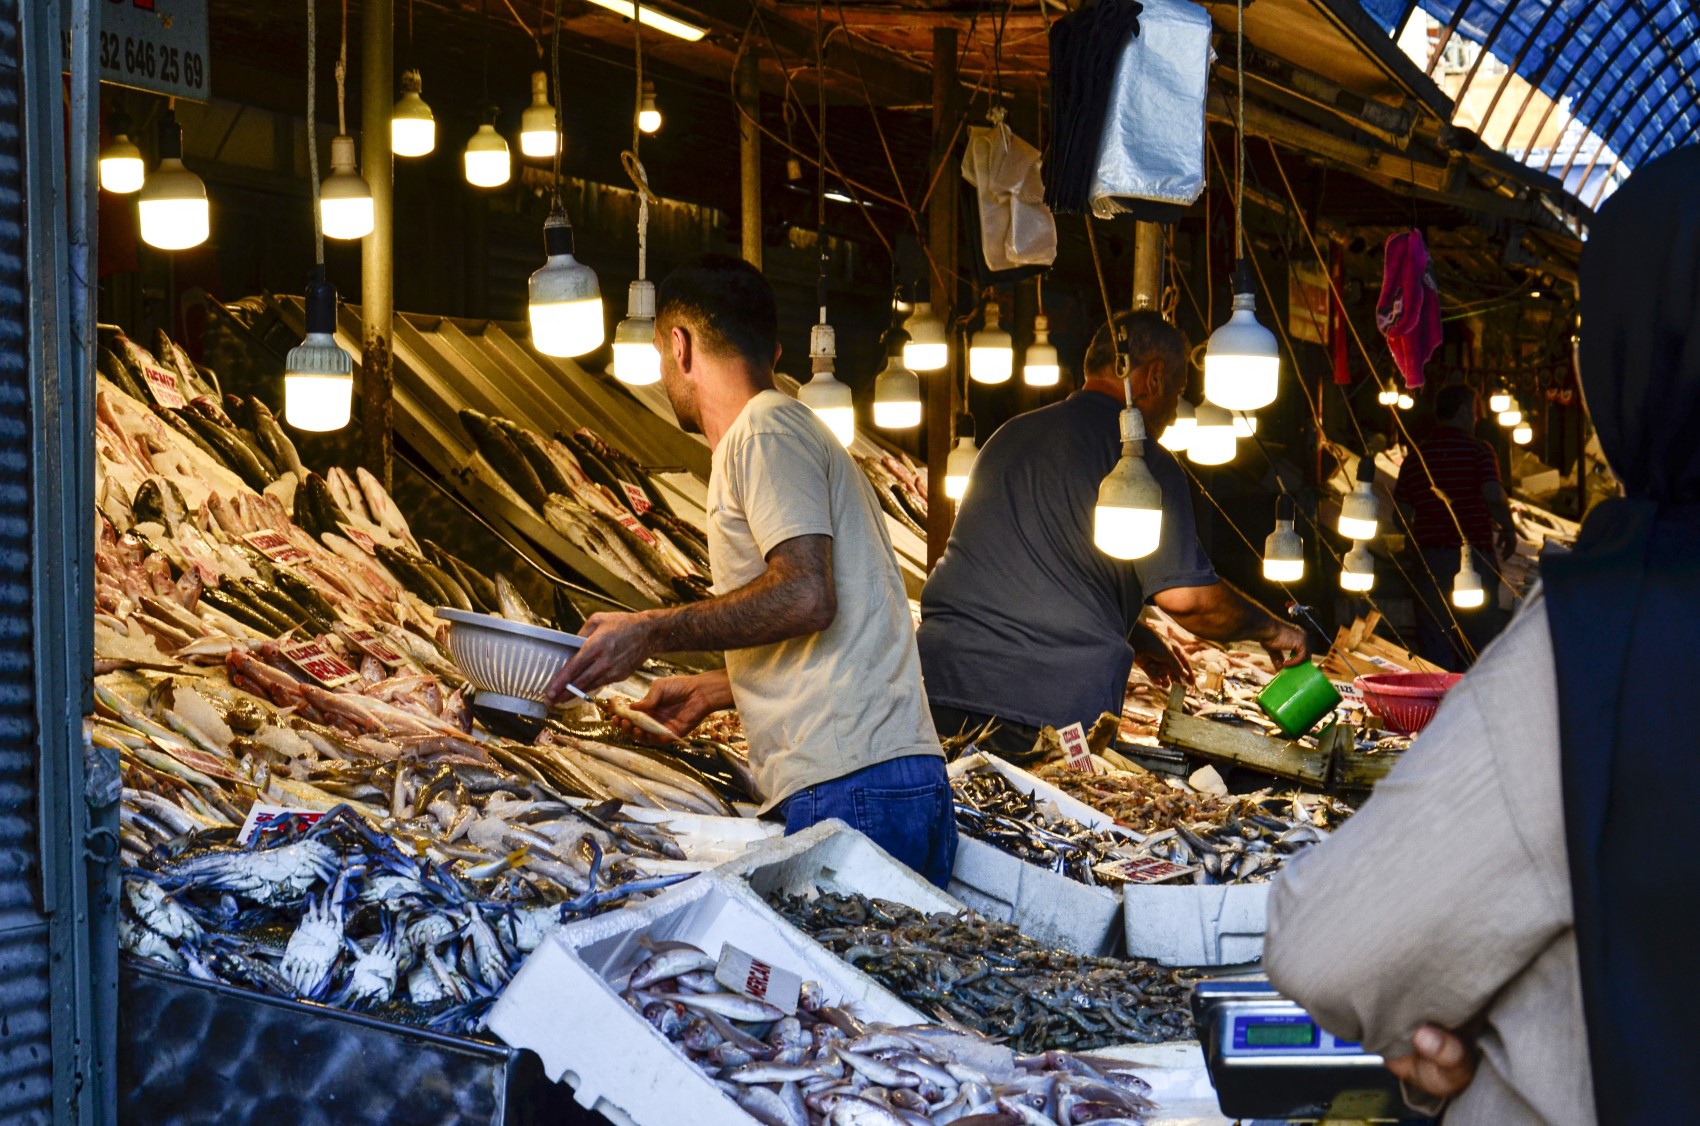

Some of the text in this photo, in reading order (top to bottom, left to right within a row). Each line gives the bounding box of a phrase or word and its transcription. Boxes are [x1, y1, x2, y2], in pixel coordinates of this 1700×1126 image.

[125, 36, 155, 79] 646
[160, 45, 180, 84] 25
[184, 51, 203, 89] 69
[745, 958, 772, 1000] MERCAN
